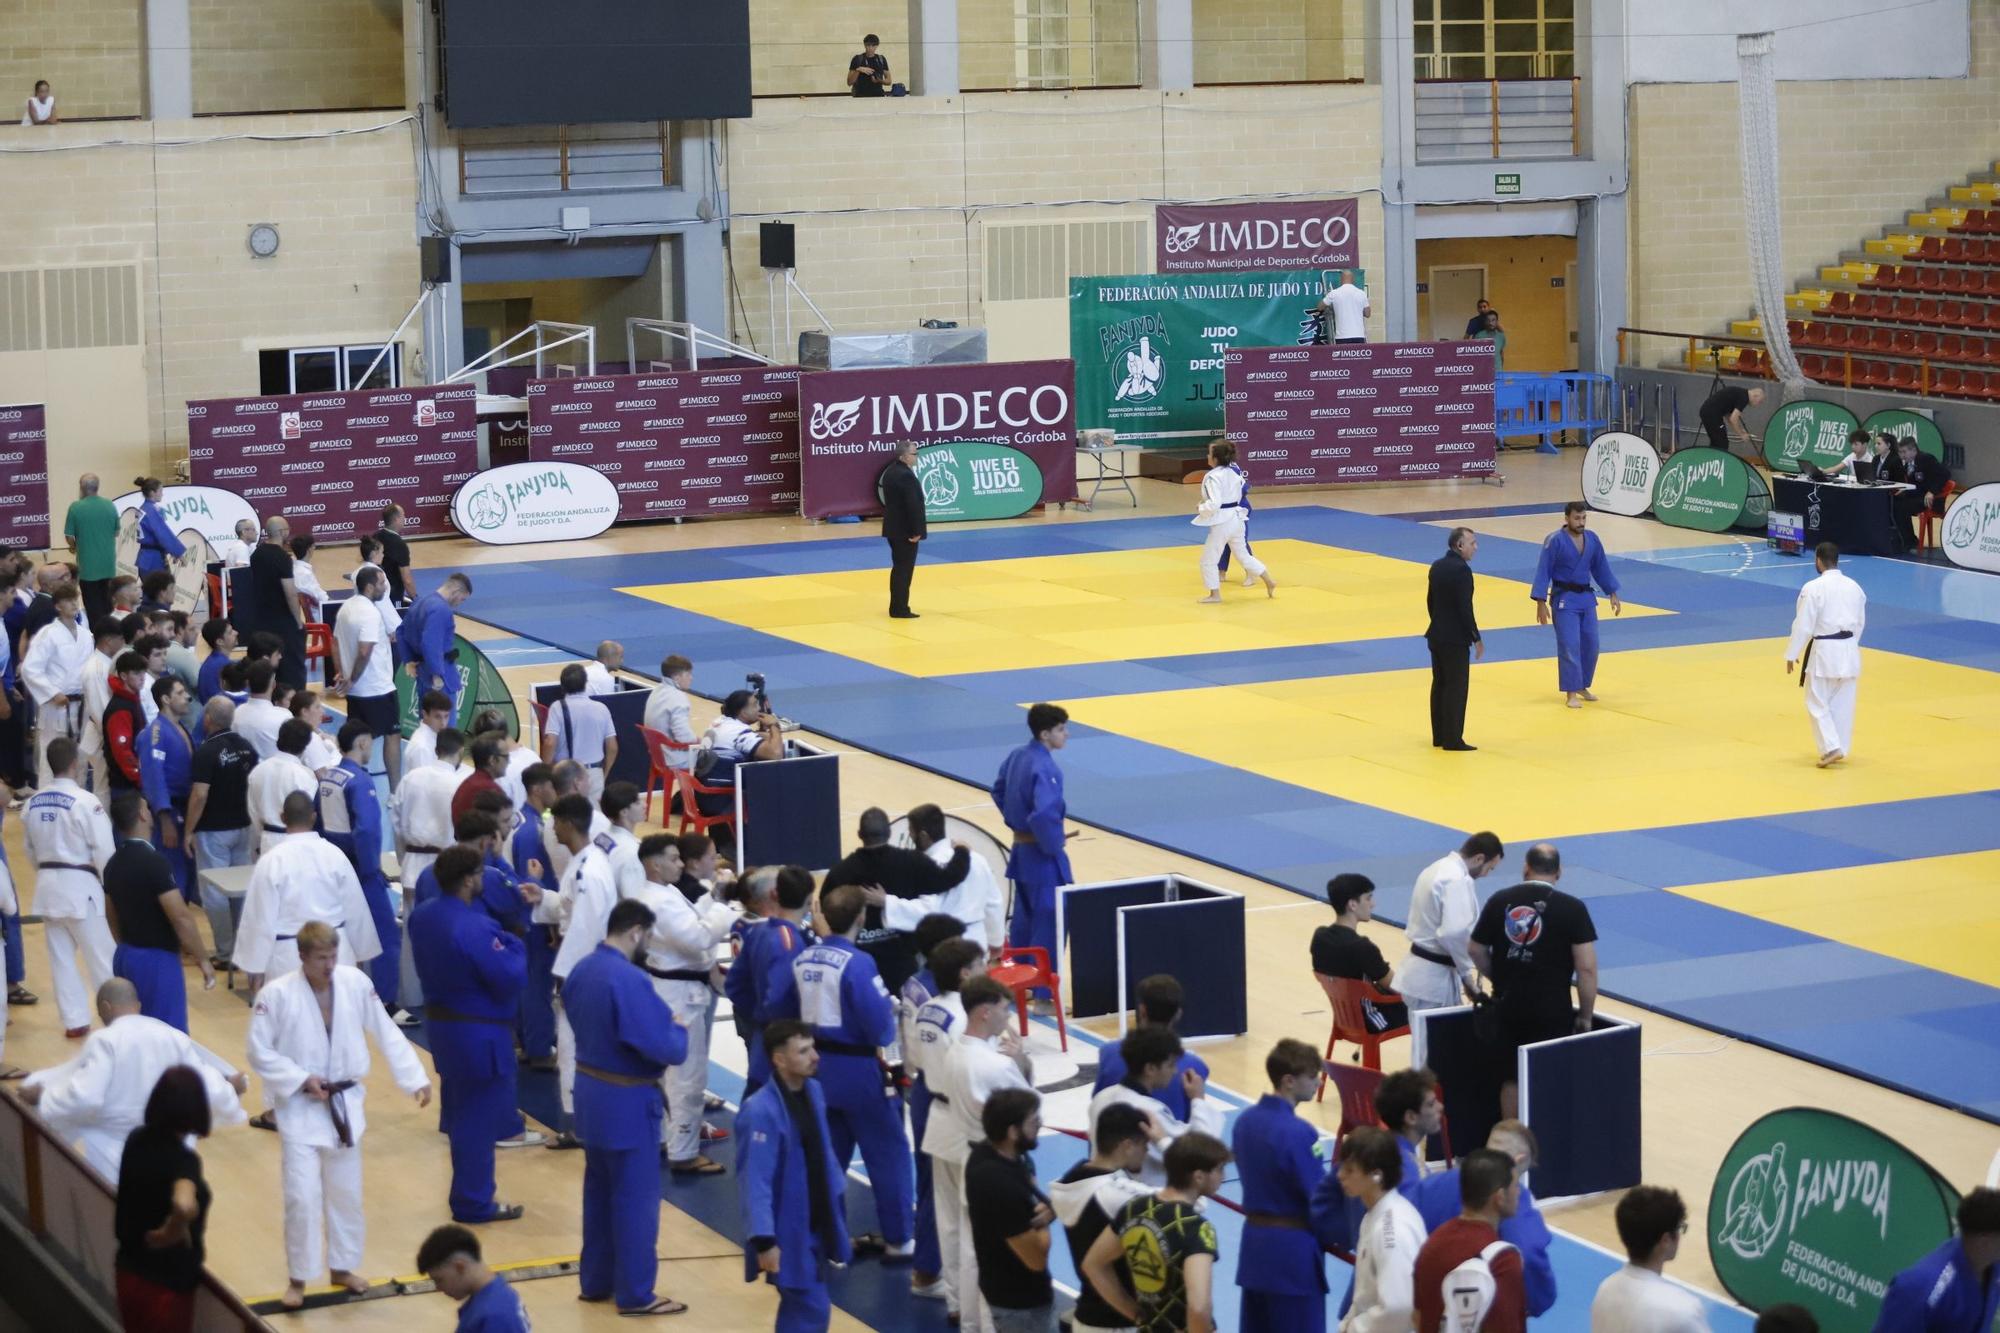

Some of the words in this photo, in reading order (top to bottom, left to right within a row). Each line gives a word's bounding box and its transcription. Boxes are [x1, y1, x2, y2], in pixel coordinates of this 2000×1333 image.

[1209, 216, 1350, 252] IMDECO
[1166, 259, 1204, 269] Instituto
[1207, 257, 1251, 270] Municipal
[1254, 256, 1266, 266] de
[1268, 254, 1310, 268] Deportes
[1312, 252, 1350, 264] Córdoba
[1099, 282, 1178, 302] FEDERACIÓN
[1183, 284, 1245, 300] ANDALUZA
[1249, 284, 1265, 298] DE
[1267, 282, 1300, 299] JUDO
[1301, 282, 1312, 296] Y
[1201, 327, 1238, 338] JUDO
[1099, 312, 1171, 363] FANJYDA
[1341, 350, 1372, 358] IMDECO
[1403, 348, 1434, 356] IMDECO
[1465, 345, 1495, 354] IMDECO
[1278, 352, 1309, 360] IMDECO
[1318, 369, 1350, 378] IMDECO
[1381, 367, 1412, 376] IMDECO
[1443, 365, 1474, 373] IMDECO
[709, 374, 741, 383] IMDECO
[1256, 371, 1287, 380] IMDECO
[582, 380, 614, 390] IMDECO
[646, 377, 678, 387] IMDECO
[1283, 390, 1315, 398] IMDECO
[1346, 388, 1377, 396] IMDECO
[1408, 385, 1439, 394] IMDECO
[379, 393, 412, 403] IMDECO
[688, 396, 719, 405] IMDECO
[750, 392, 782, 401] IMDECO
[245, 402, 279, 411] IMDECO
[312, 398, 346, 407] IMDECO
[560, 403, 592, 411] IMDECO
[624, 399, 656, 408] IMDECO
[871, 385, 1068, 435] IMDECO
[1319, 408, 1350, 416] IMDECO
[1381, 405, 1413, 414] IMDECO
[1443, 403, 1474, 412] IMDECO
[715, 414, 747, 423] IMDECO
[1256, 410, 1288, 418] IMDECO
[1785, 406, 1814, 430] FANJYDA
[356, 416, 389, 425] IMDECO
[652, 418, 684, 427] IMDECO
[222, 424, 256, 433] IMDECO
[588, 421, 620, 430] IMDECO
[1408, 425, 1440, 433] IMDECO
[1820, 419, 1839, 433] VIVE
[1839, 421, 1848, 436] EL
[1284, 430, 1315, 438] IMDECO
[1346, 427, 1378, 435] IMDECO
[385, 434, 418, 443] IMDECO
[689, 436, 721, 445] IMDECO
[752, 432, 783, 441] IMDECO
[319, 439, 352, 448] IMDECO
[626, 439, 657, 448] IMDECO
[812, 443, 864, 455] Instituto
[1014, 430, 1066, 444] Córdoba
[1814, 432, 1846, 451] JUDO
[252, 443, 285, 452] IMDECO
[562, 443, 593, 452] IMDECO
[1319, 447, 1351, 456] IMDECO
[1382, 445, 1413, 453] IMDECO
[1443, 443, 1475, 451] IMDECO
[423, 452, 456, 461] IMDECO
[1257, 450, 1288, 458] IMDECO
[357, 457, 391, 466] IMDECO
[653, 459, 685, 467] IMDECO
[716, 455, 748, 464] IMDECO
[1625, 454, 1640, 469] VIVE
[1641, 456, 1649, 469] EL
[291, 461, 325, 470] IMDECO
[970, 459, 1000, 472] VIVE
[1003, 457, 1019, 470] EL
[1408, 463, 1440, 471] IMDECO
[224, 466, 257, 475] IMDECO
[1284, 468, 1315, 476] IMDECO
[1346, 465, 1378, 474] IMDECO
[387, 476, 420, 485] IMDECO
[690, 476, 721, 485] IMDECO
[753, 473, 784, 481] IMDECO
[972, 470, 1020, 490] JUDO
[1621, 468, 1647, 488] JUDO
[1685, 458, 1724, 494] FANJYDA
[320, 481, 354, 490] IMDECO
[626, 480, 658, 489] IMDECO
[253, 486, 287, 495] IMDECO
[505, 470, 573, 512] FANJYDA
[654, 499, 686, 508] IMDECO
[717, 495, 749, 504] IMDECO
[292, 504, 326, 513] IMDECO
[322, 522, 354, 531] IMDECO
[518, 519, 528, 527] DE
[530, 518, 549, 527] JUDO
[1789, 1158, 1890, 1240] FANJYDA
[1787, 1240, 1857, 1287] FEDERACIÓN
[1781, 1258, 1797, 1276] DE
[1796, 1265, 1828, 1294] JUDO
[1827, 1281, 1835, 1296] Y
